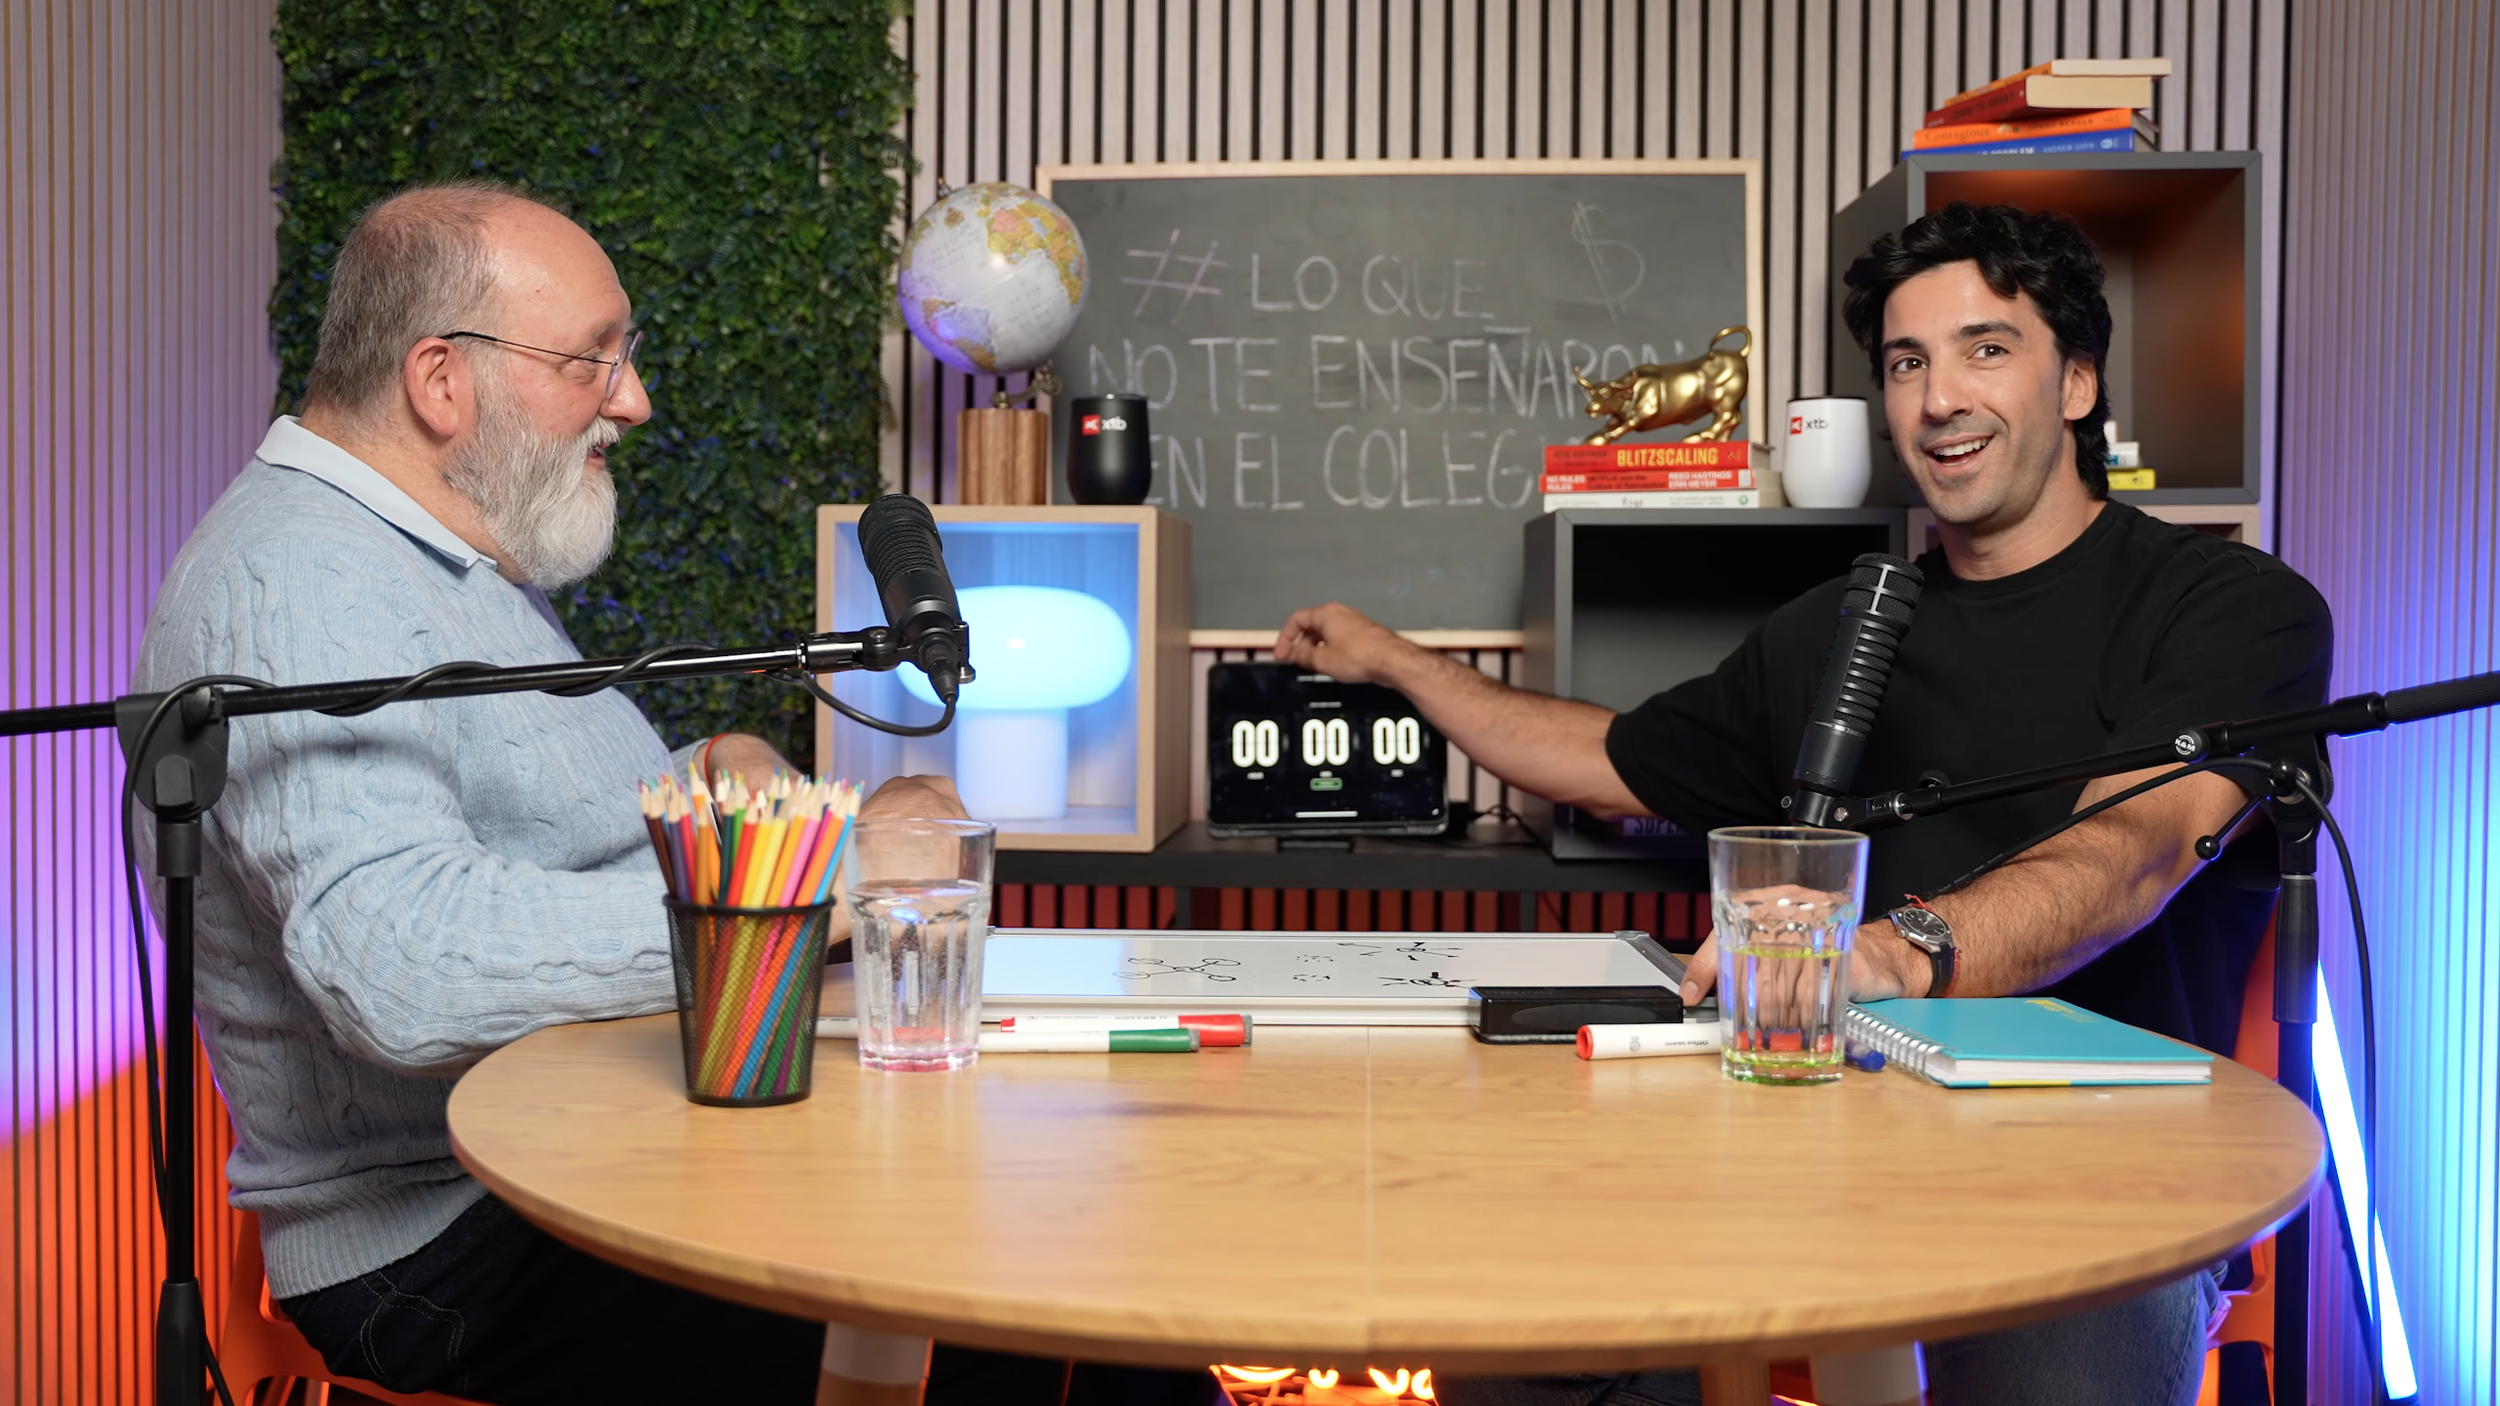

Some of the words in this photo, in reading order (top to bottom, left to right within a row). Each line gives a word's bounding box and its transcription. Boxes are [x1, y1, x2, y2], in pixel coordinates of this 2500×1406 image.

[1361, 253, 1495, 320] QUE
[1088, 337, 1178, 411] NO
[1189, 336, 1283, 414] TE
[1101, 415, 1128, 431] xtb
[1804, 417, 1829, 430] xtb
[1616, 446, 1719, 467] BLITZSCALING
[1233, 432, 1304, 511] EL
[1324, 424, 1588, 509] COLEG
[1546, 474, 1558, 484] NO
[1559, 474, 1586, 483] RULES
[1668, 471, 1689, 481] REED
[1691, 470, 1733, 480] HASTINGS
[1546, 483, 1573, 492] RULES
[1668, 480, 1686, 489] ERIN
[1687, 479, 1718, 488] MEYER
[1232, 720, 1279, 768] 00
[1302, 718, 1350, 766] 00
[1372, 717, 1420, 765] 00
[2174, 737, 2196, 752] KAM
